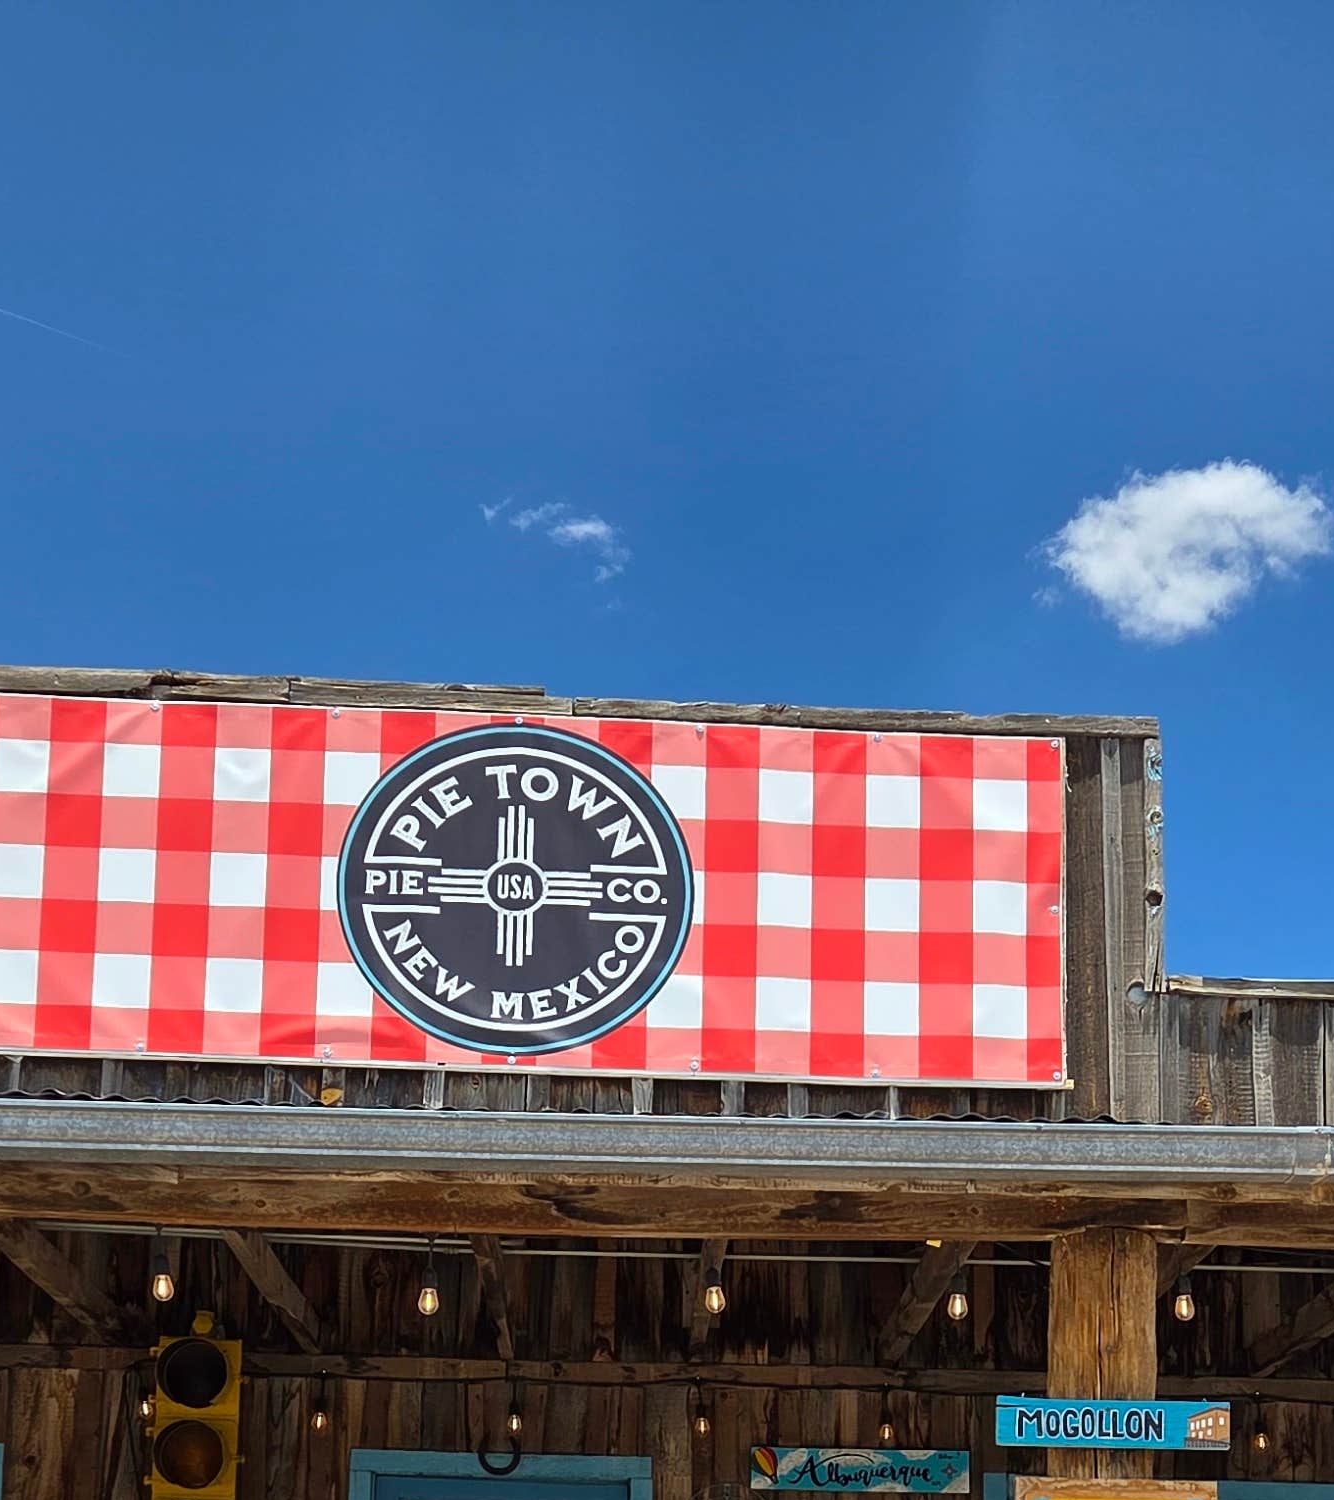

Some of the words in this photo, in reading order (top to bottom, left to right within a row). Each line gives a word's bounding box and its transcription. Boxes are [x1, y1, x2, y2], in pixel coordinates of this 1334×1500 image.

[390, 775, 473, 852] PIE
[485, 764, 646, 858] TOWN
[365, 869, 424, 895] PIE
[607, 878, 667, 904] CO.
[497, 873, 534, 900] USA
[382, 919, 476, 1002] NEW
[490, 924, 646, 1020] MEXICO
[1016, 1408, 1164, 1440] MOGOLLON
[786, 1454, 932, 1487] Albuquerque
